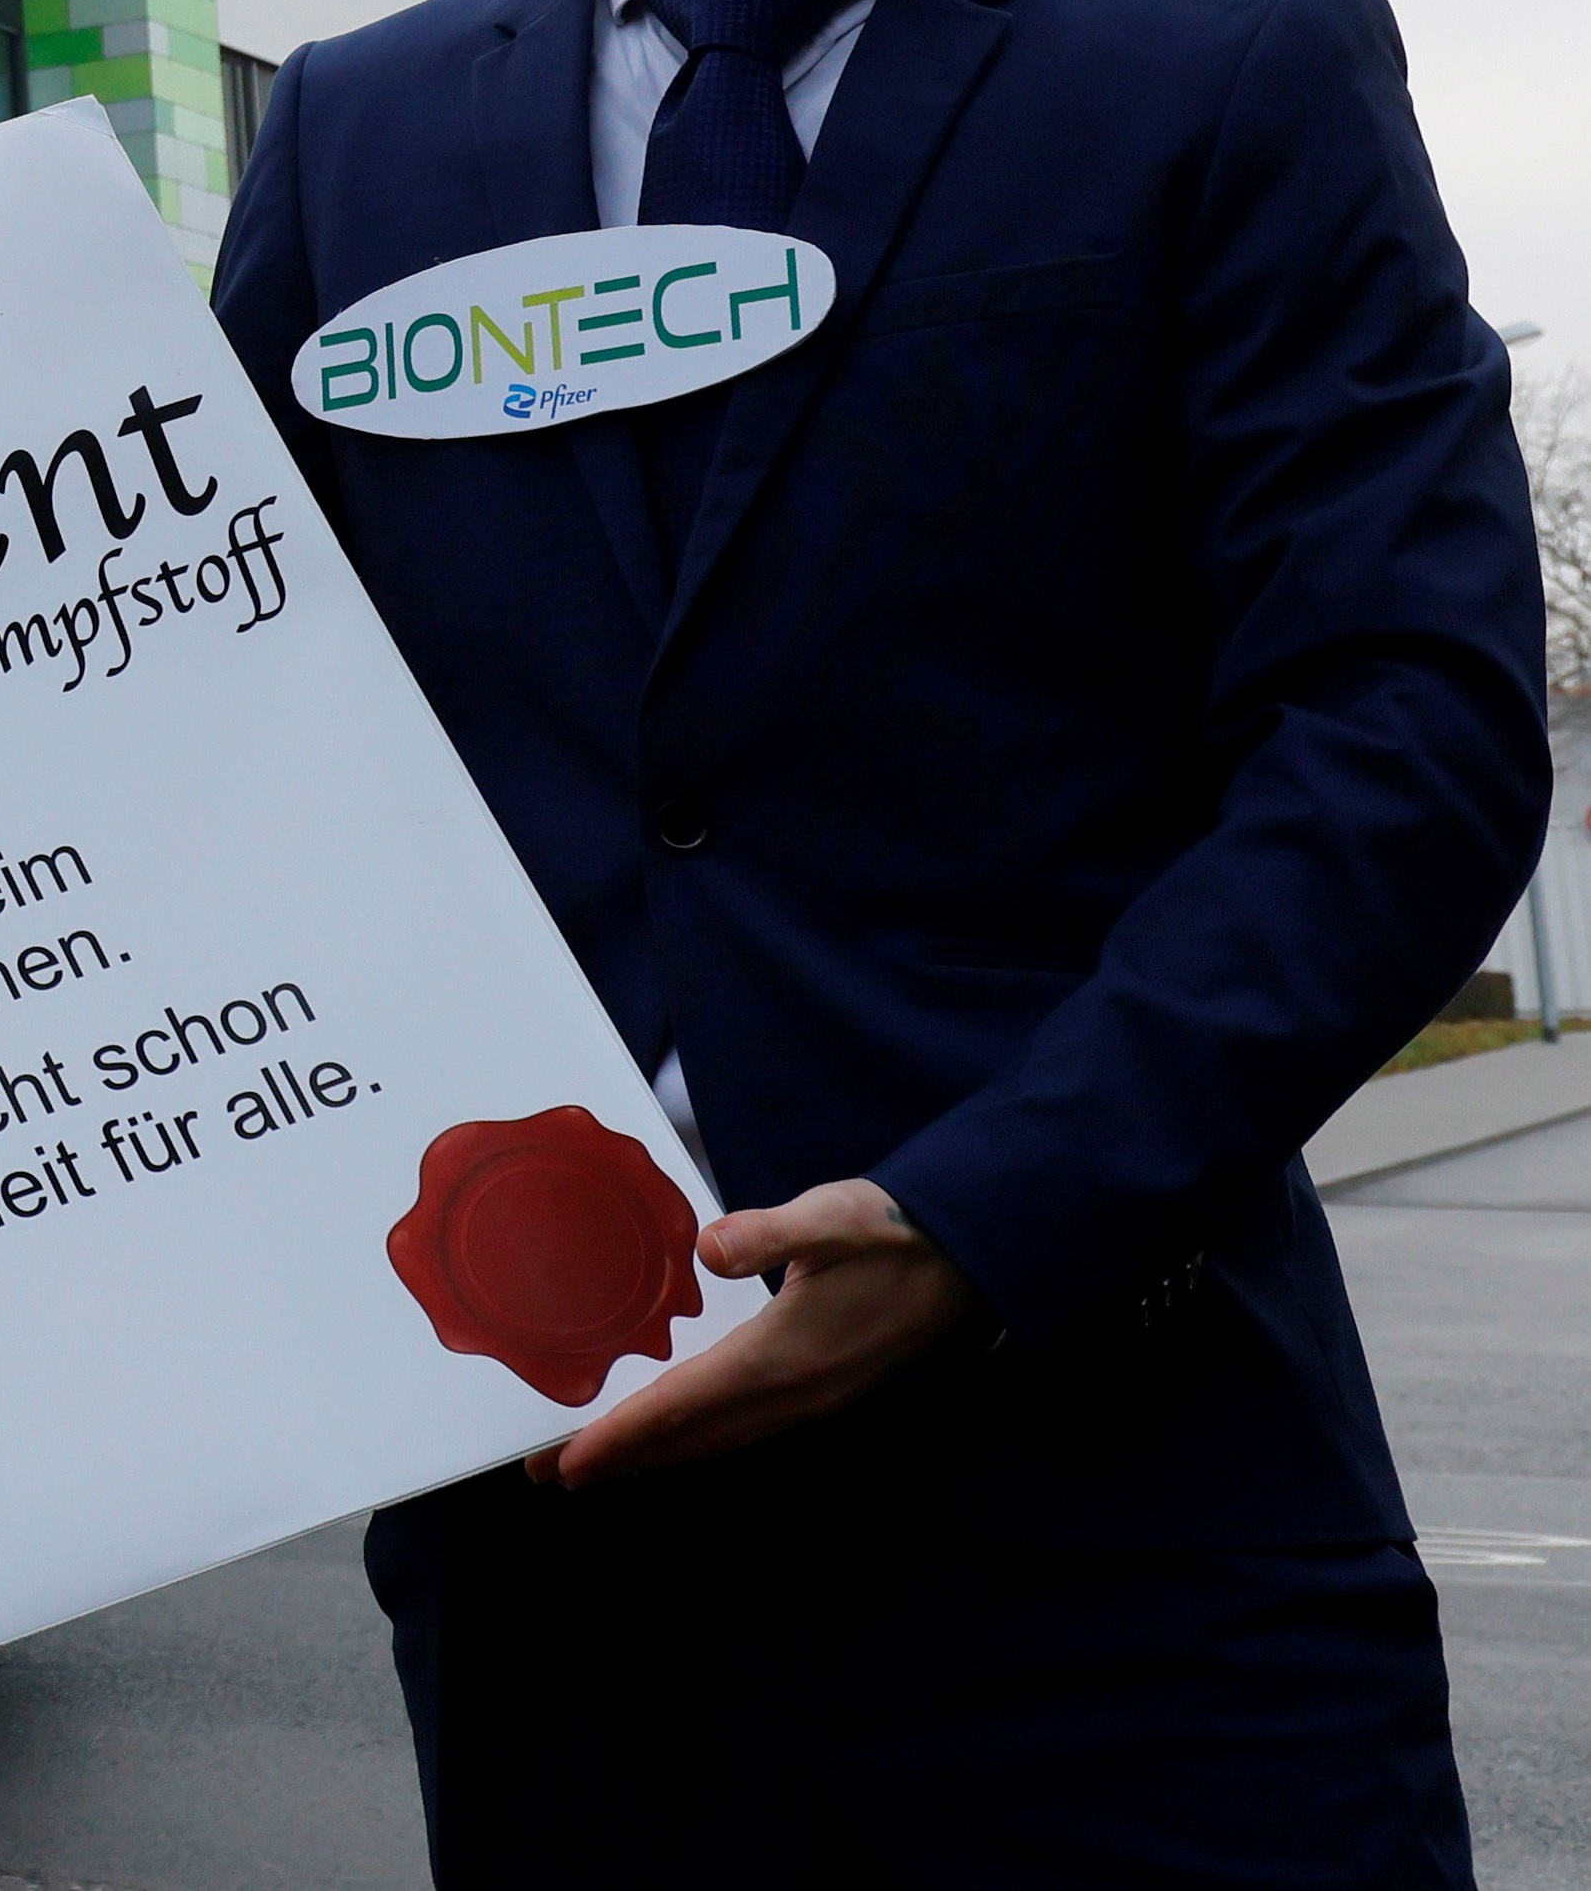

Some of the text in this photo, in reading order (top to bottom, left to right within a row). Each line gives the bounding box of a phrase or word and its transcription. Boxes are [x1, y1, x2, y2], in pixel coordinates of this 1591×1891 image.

[319, 247, 802, 412] BIONTECH
[539, 382, 598, 419] Pfizer
[92, 982, 316, 1091] schon
[100, 1110, 201, 1183] für
[226, 1060, 382, 1140] alle.
